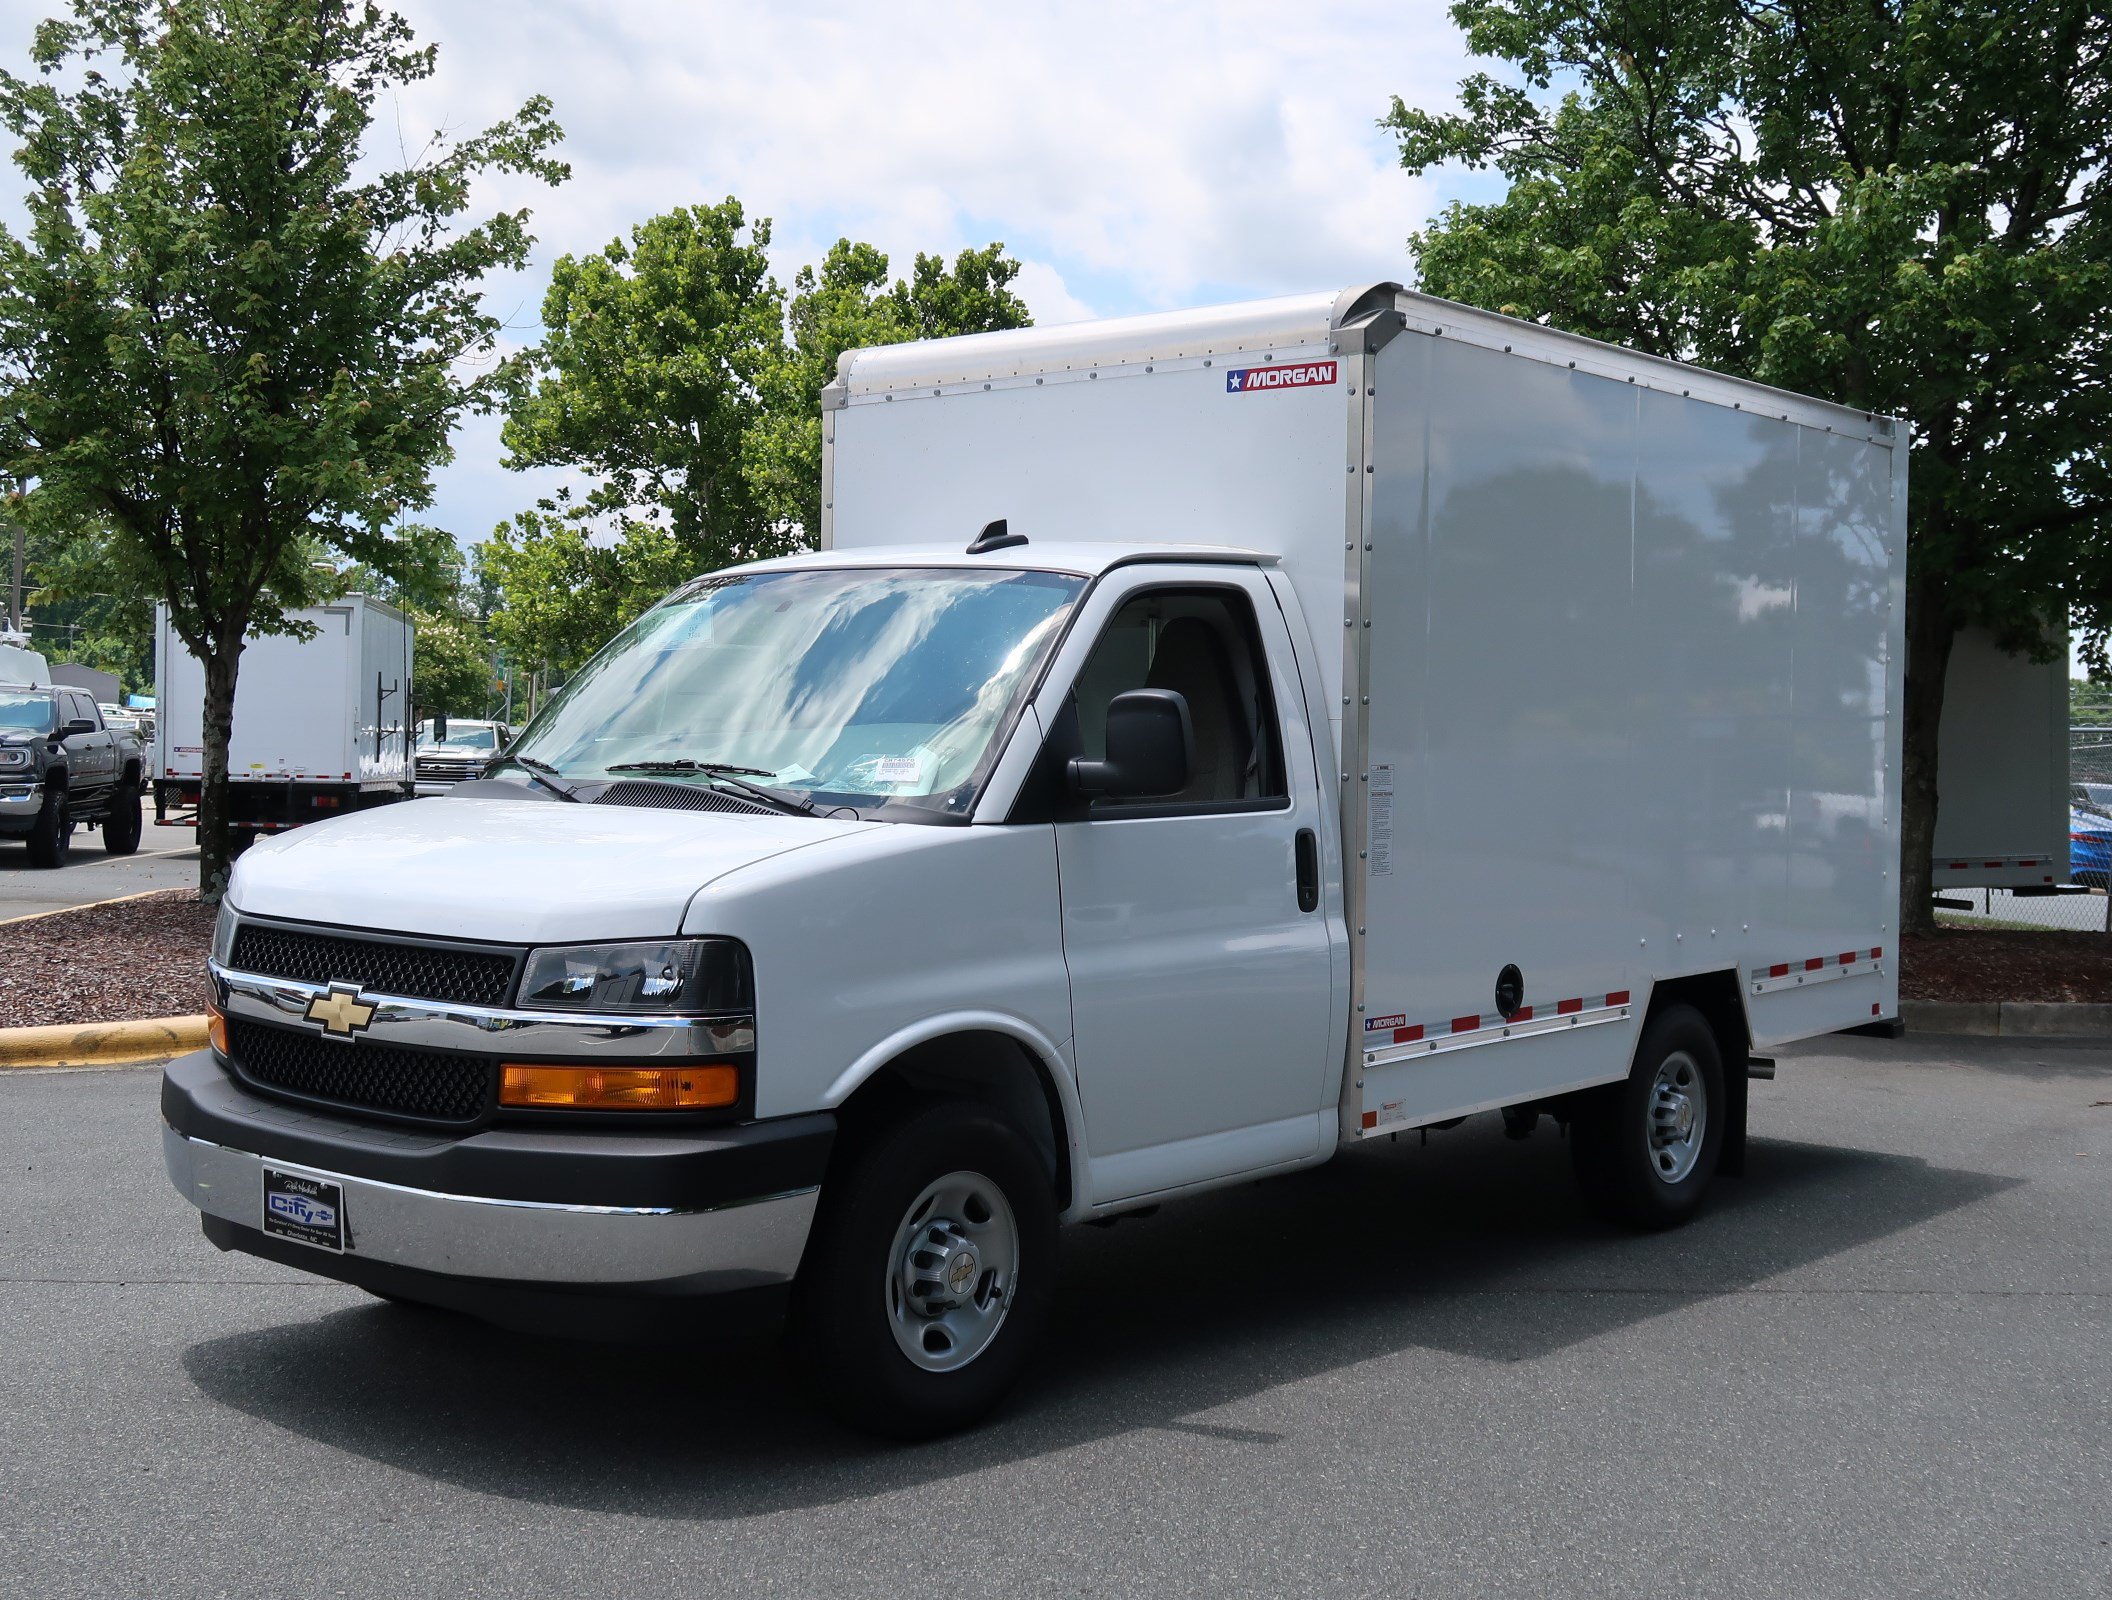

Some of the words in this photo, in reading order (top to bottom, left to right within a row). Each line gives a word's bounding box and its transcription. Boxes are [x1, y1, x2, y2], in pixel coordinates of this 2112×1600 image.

[1246, 366, 1332, 388] MORGAN
[1372, 1016, 1405, 1029] MORGAN
[271, 1196, 313, 1222] City
